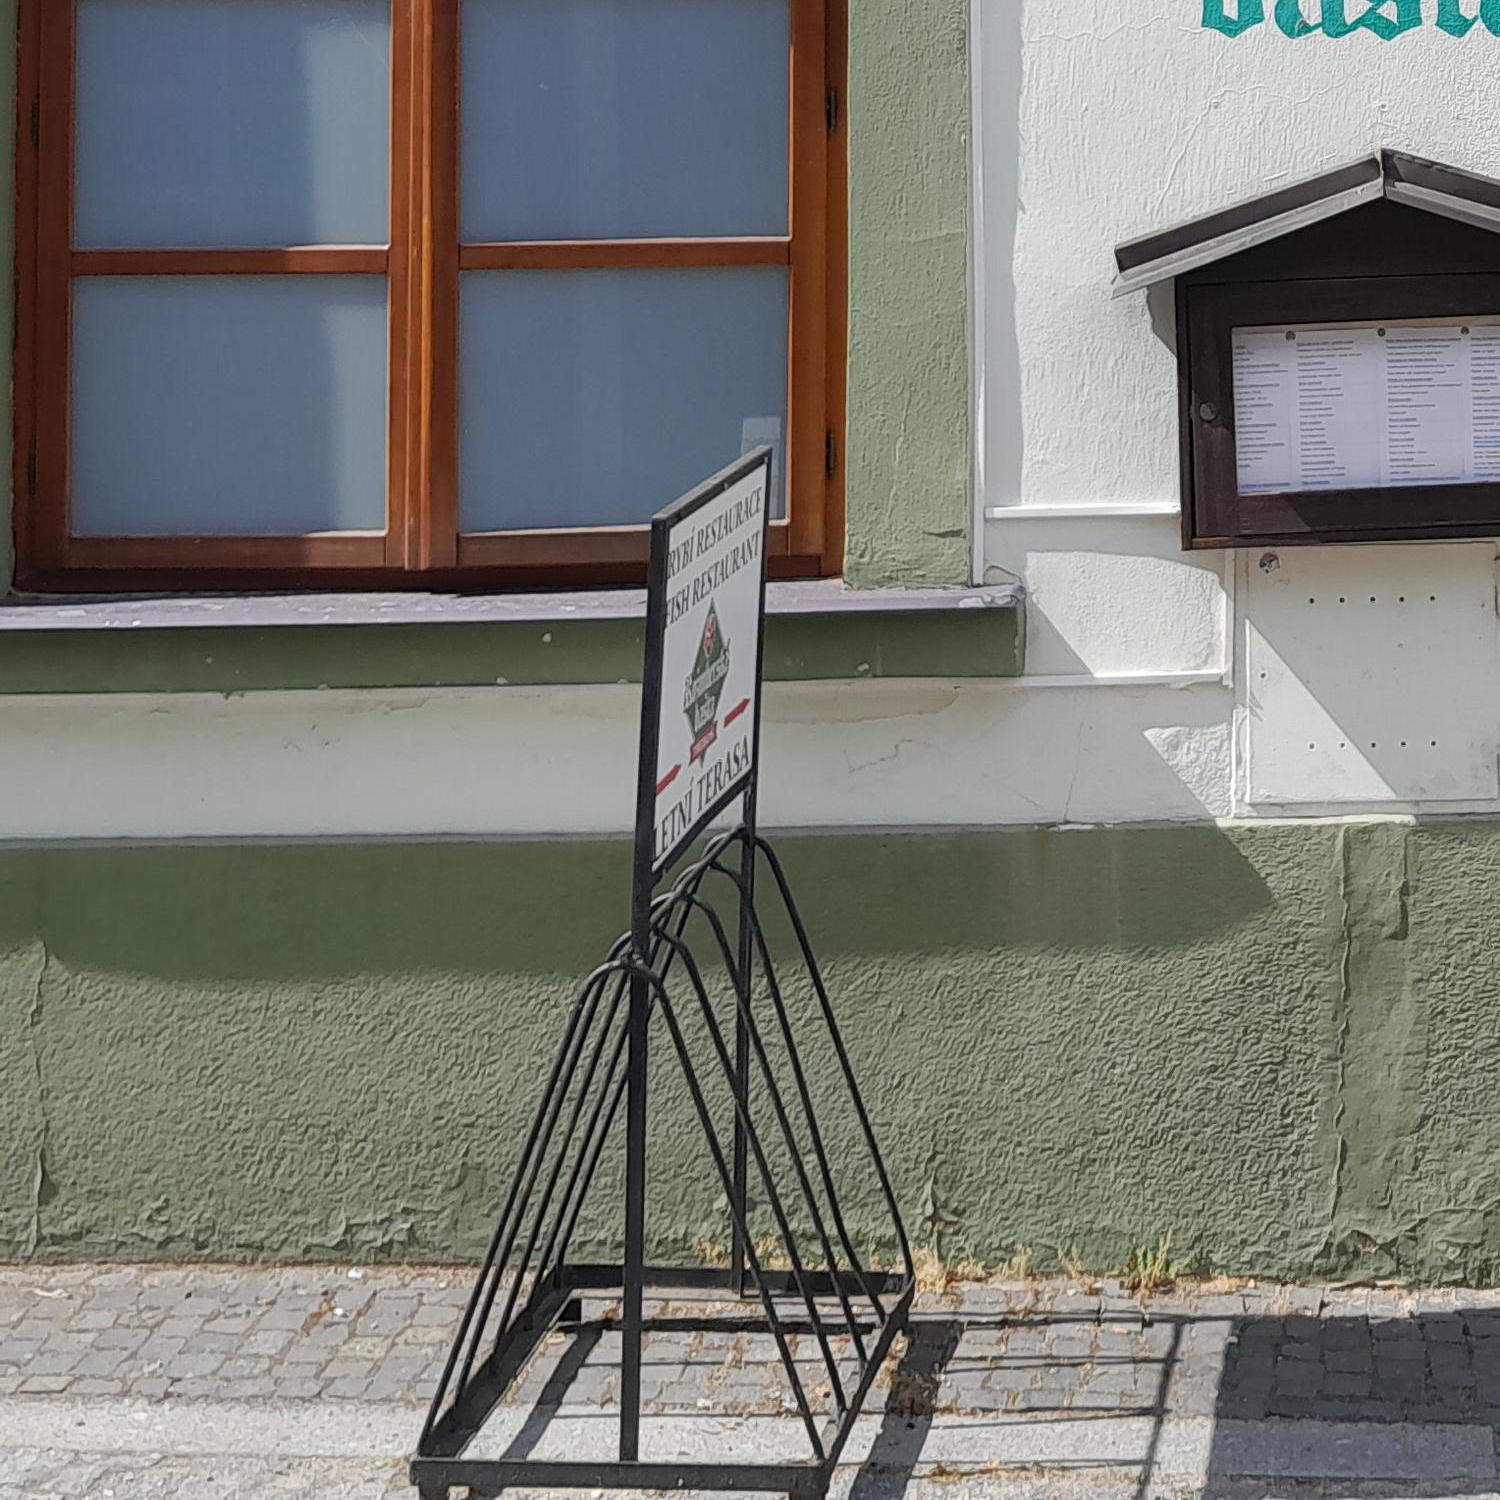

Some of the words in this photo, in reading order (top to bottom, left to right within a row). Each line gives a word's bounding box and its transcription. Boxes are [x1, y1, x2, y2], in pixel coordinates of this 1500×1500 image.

[667, 527, 695, 580] RYBÍ
[696, 486, 763, 557] RESTAURACE
[692, 530, 761, 606] RESTAURANT
[697, 735, 750, 814] TERASA
